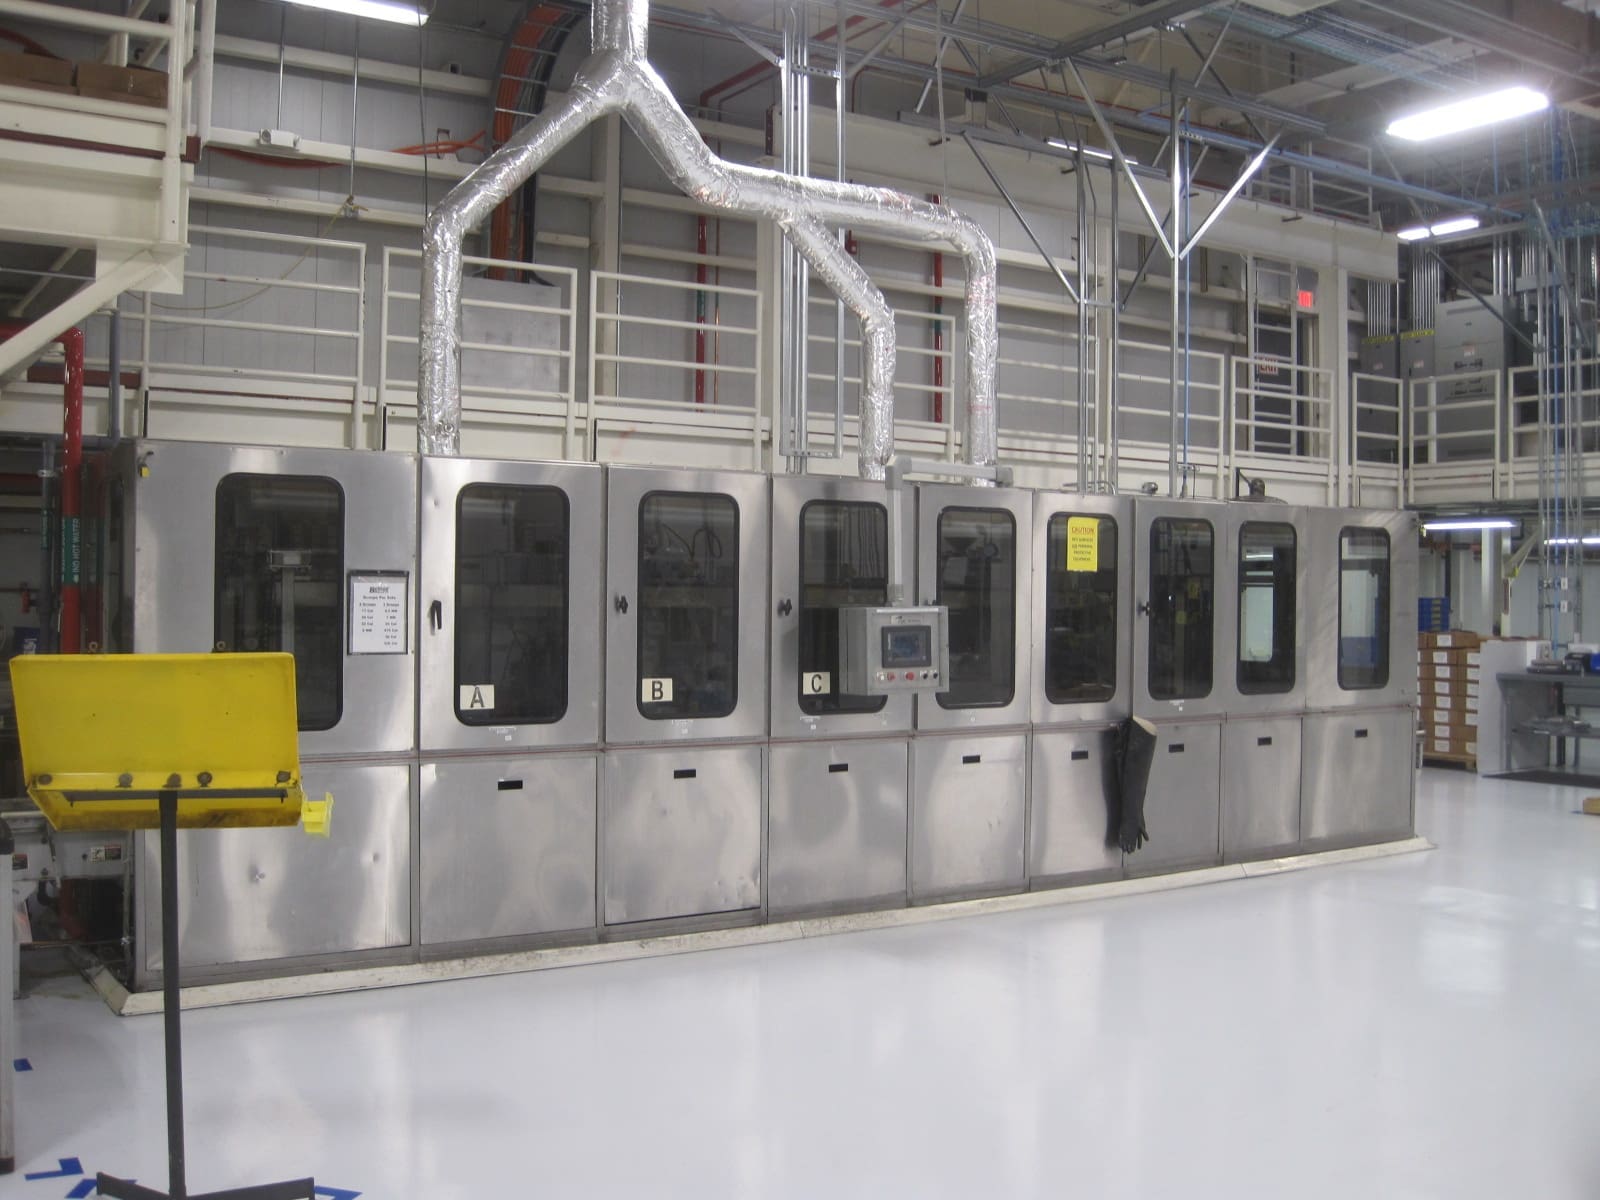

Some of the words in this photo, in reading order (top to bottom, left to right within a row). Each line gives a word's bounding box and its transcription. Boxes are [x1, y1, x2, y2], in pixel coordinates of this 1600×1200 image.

[651, 680, 664, 700] B
[811, 674, 822, 693] C
[470, 686, 485, 708] A
